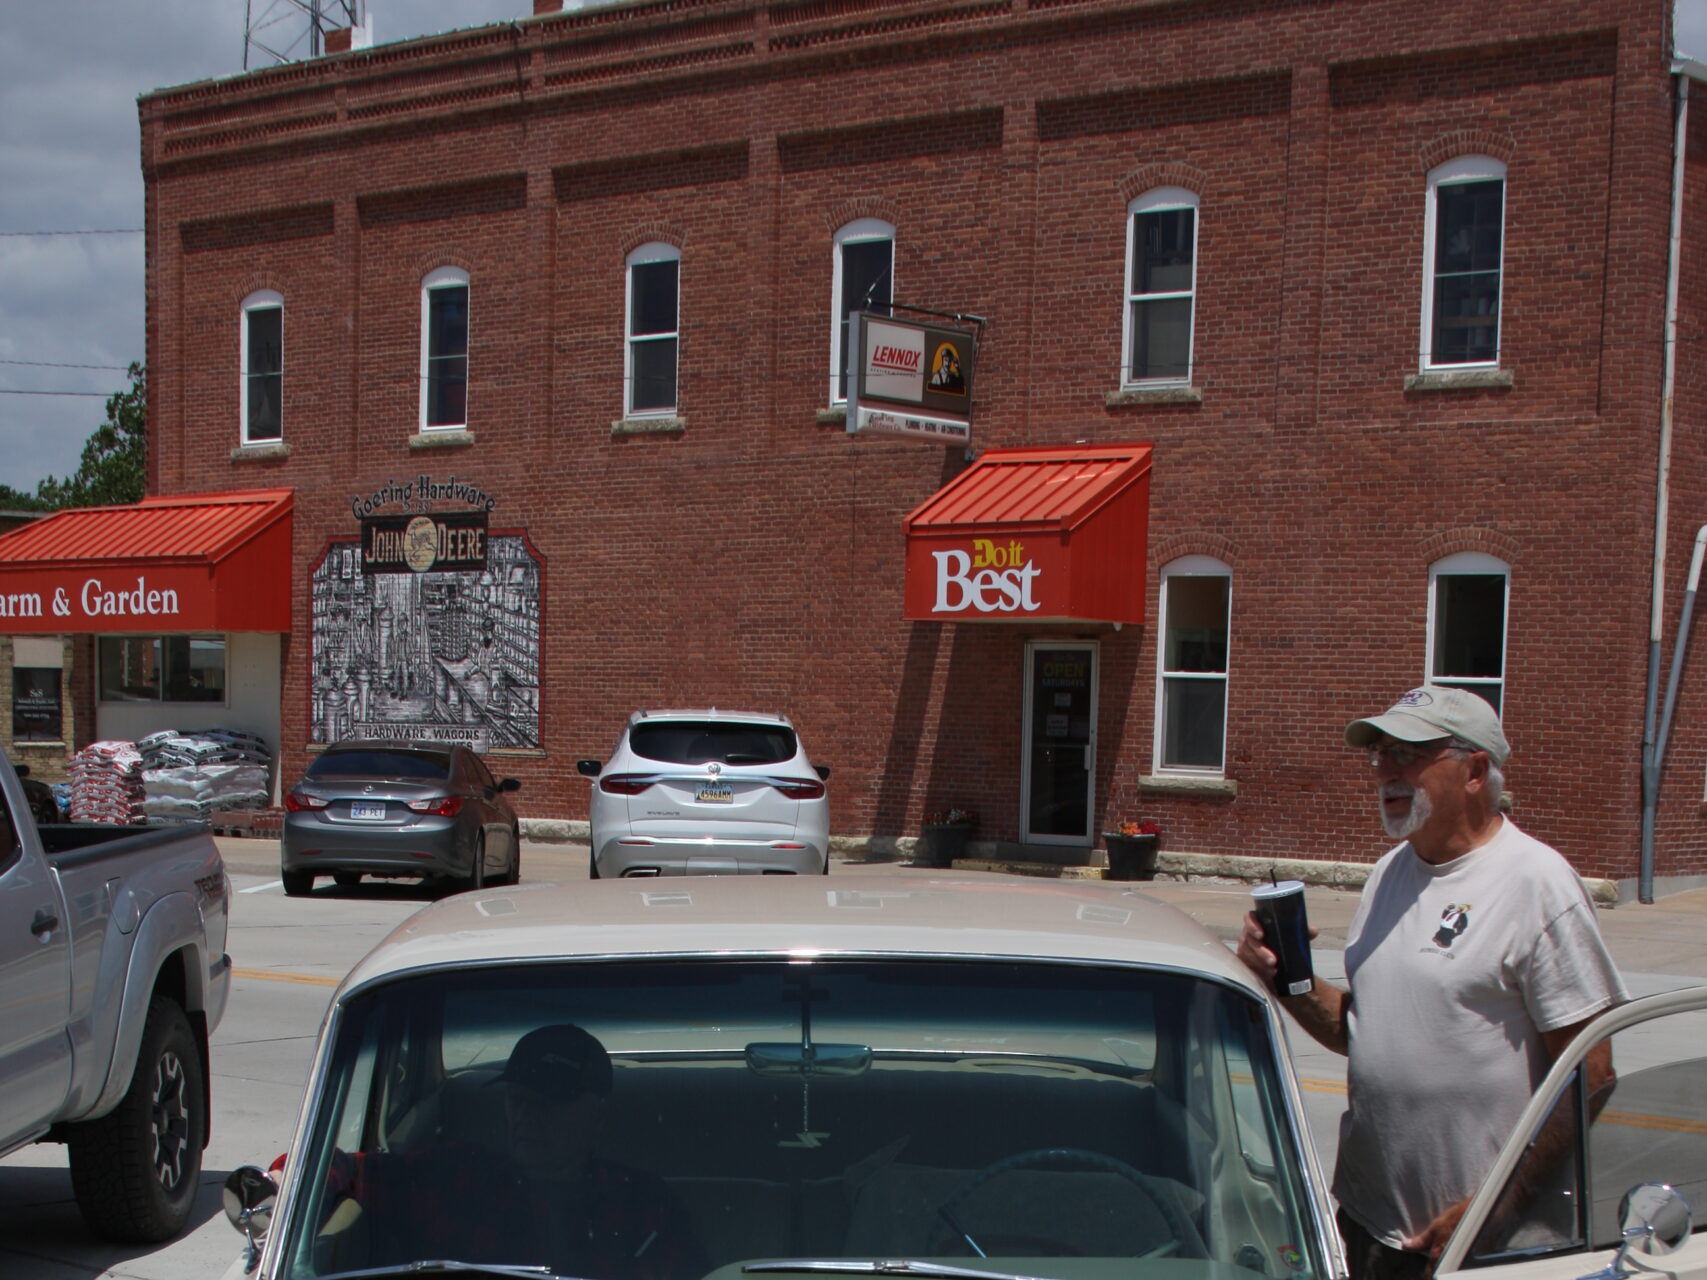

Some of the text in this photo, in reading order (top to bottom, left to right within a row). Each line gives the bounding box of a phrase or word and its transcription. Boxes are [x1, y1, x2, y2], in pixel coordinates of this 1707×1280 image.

[872, 345, 922, 368] LENNOX
[352, 474, 496, 520] Goering Hardware
[365, 522, 486, 565] JOHN DEERE
[972, 538, 1025, 568] Do it
[52, 587, 71, 616] &
[81, 576, 179, 616] Garden
[931, 548, 1042, 613] Best
[1043, 664, 1084, 677] OPEN
[433, 729, 480, 740] WAGONS
